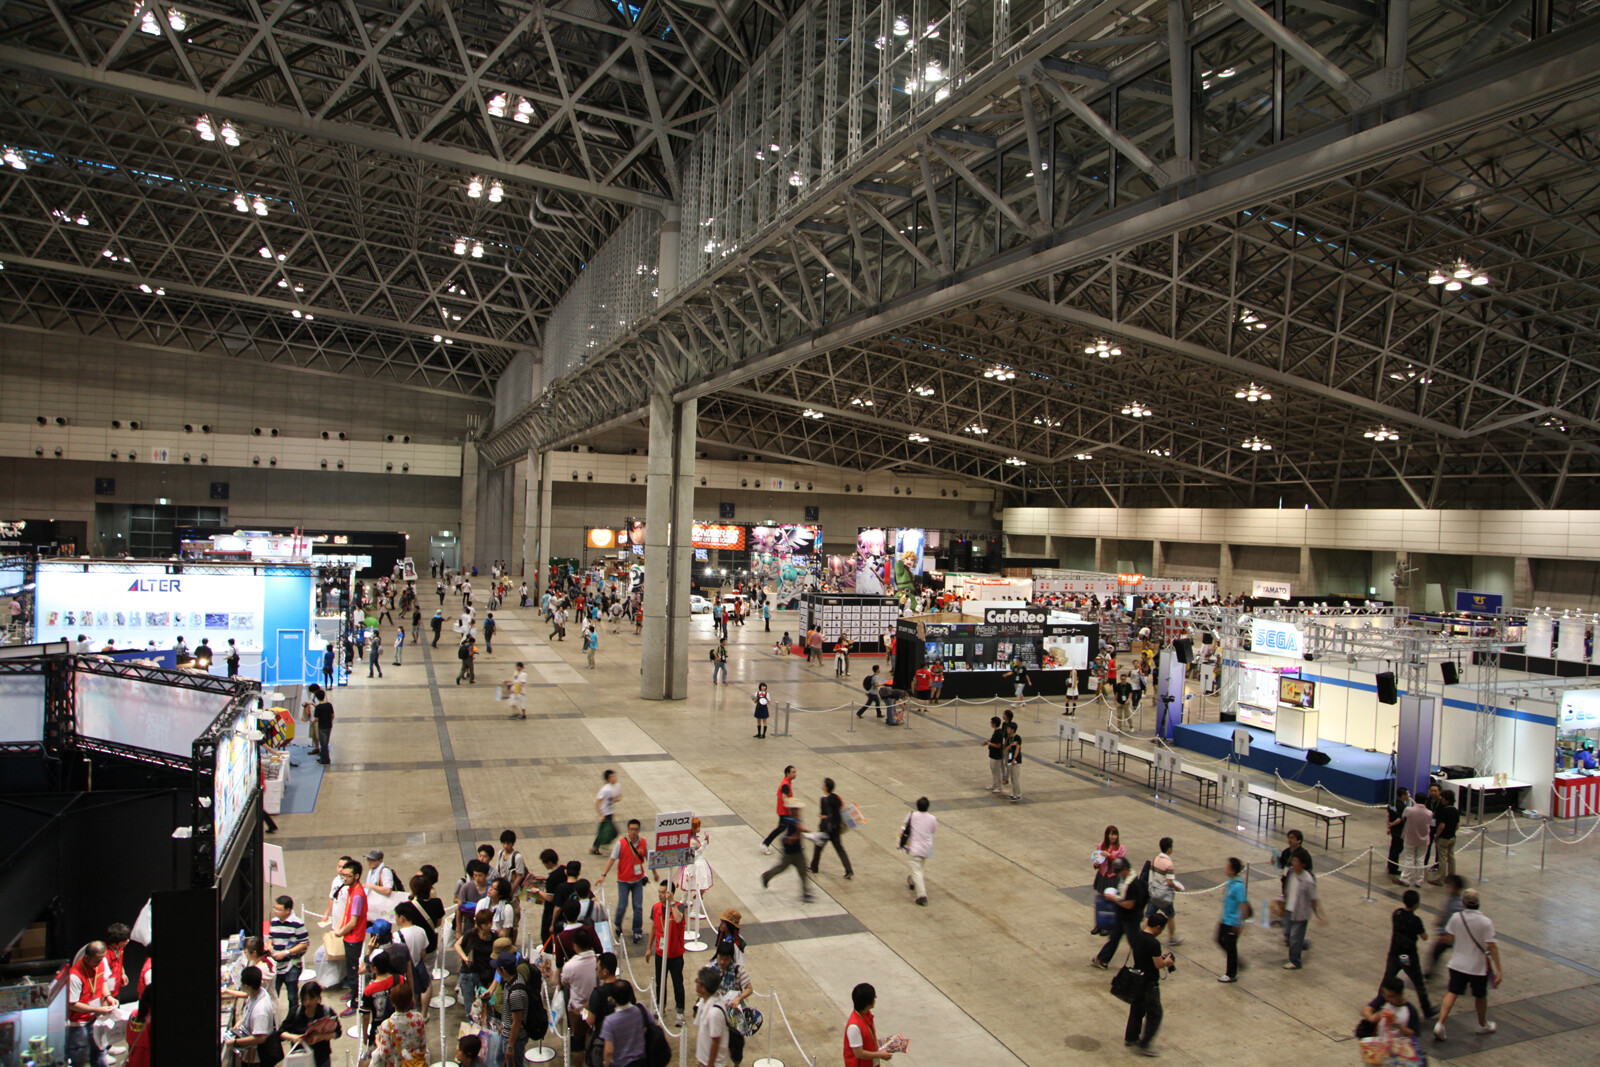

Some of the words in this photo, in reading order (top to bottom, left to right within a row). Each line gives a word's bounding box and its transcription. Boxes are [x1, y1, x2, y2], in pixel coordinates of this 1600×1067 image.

[128, 578, 182, 593] ALTER
[1263, 586, 1287, 595] YAMATO
[987, 610, 1046, 624] CaféReo
[1255, 629, 1298, 651] SEGA
[659, 816, 690, 827] メガハウス
[657, 833, 689, 847] 最後尾
